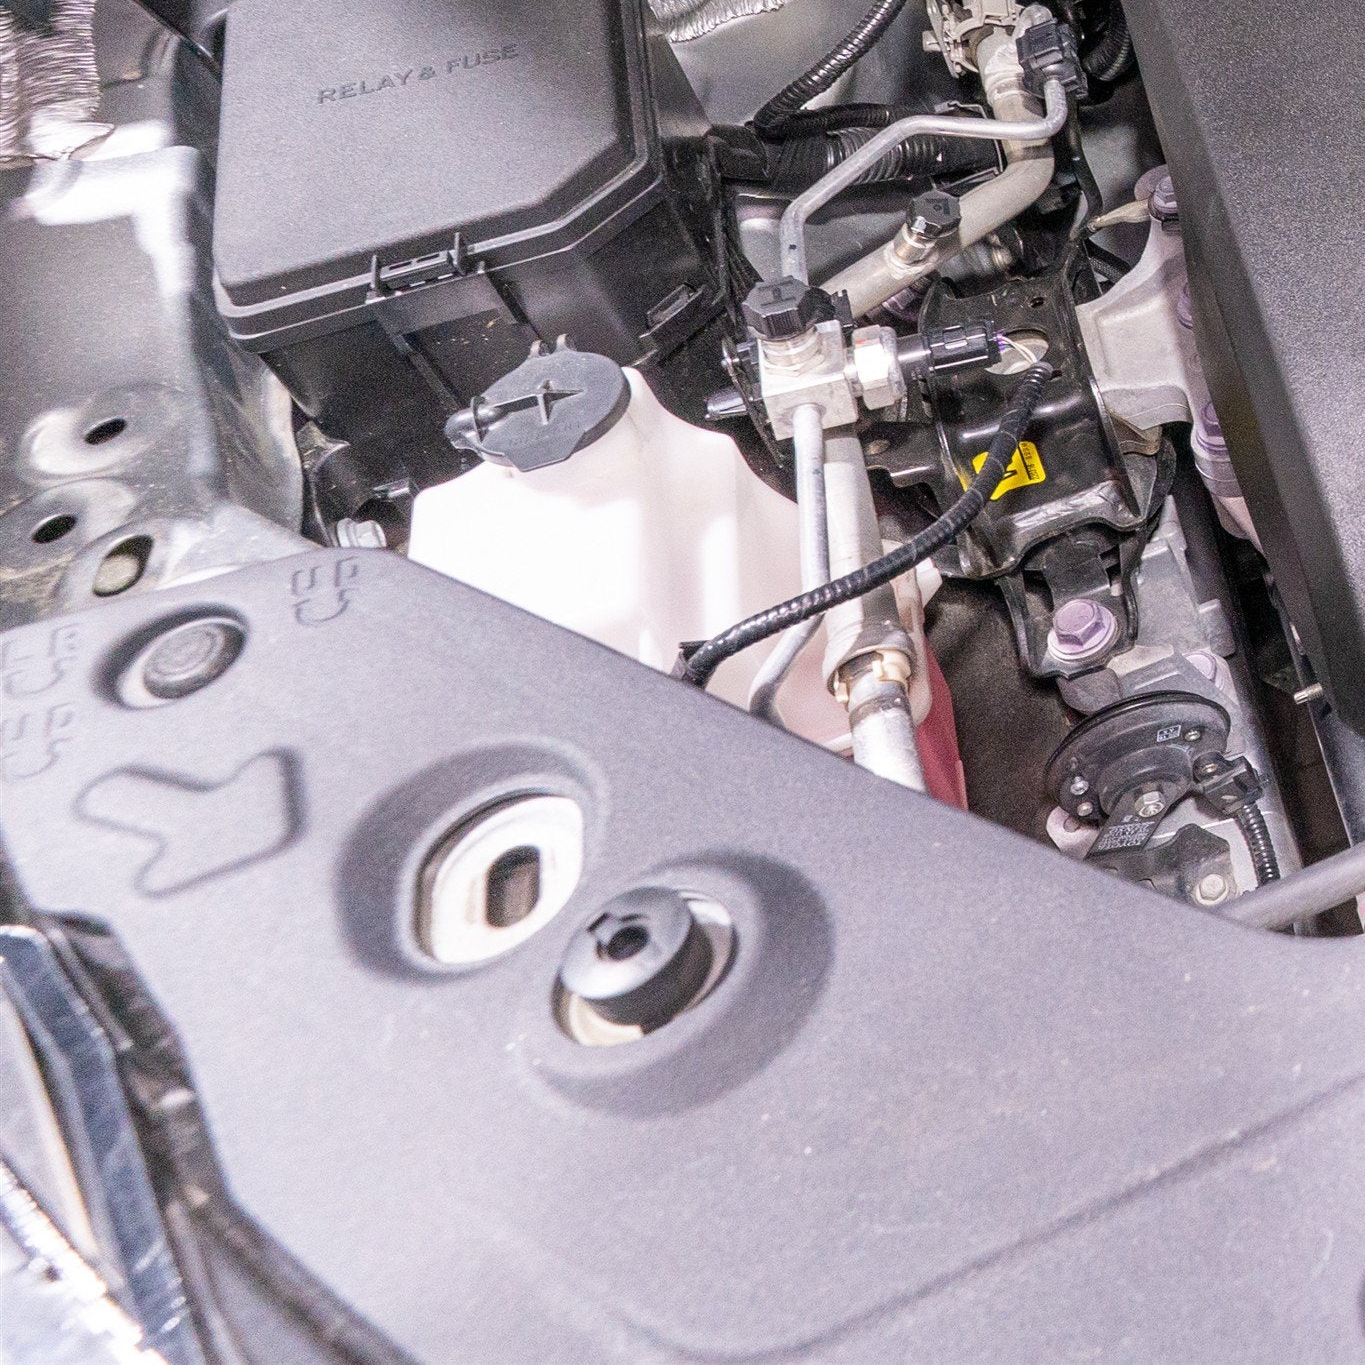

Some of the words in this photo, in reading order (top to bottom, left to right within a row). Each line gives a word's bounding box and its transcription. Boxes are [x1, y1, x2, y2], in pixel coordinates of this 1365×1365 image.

[317, 68, 413, 104] RELAY
[418, 65, 436, 81] &
[446, 43, 519, 74] FUSE
